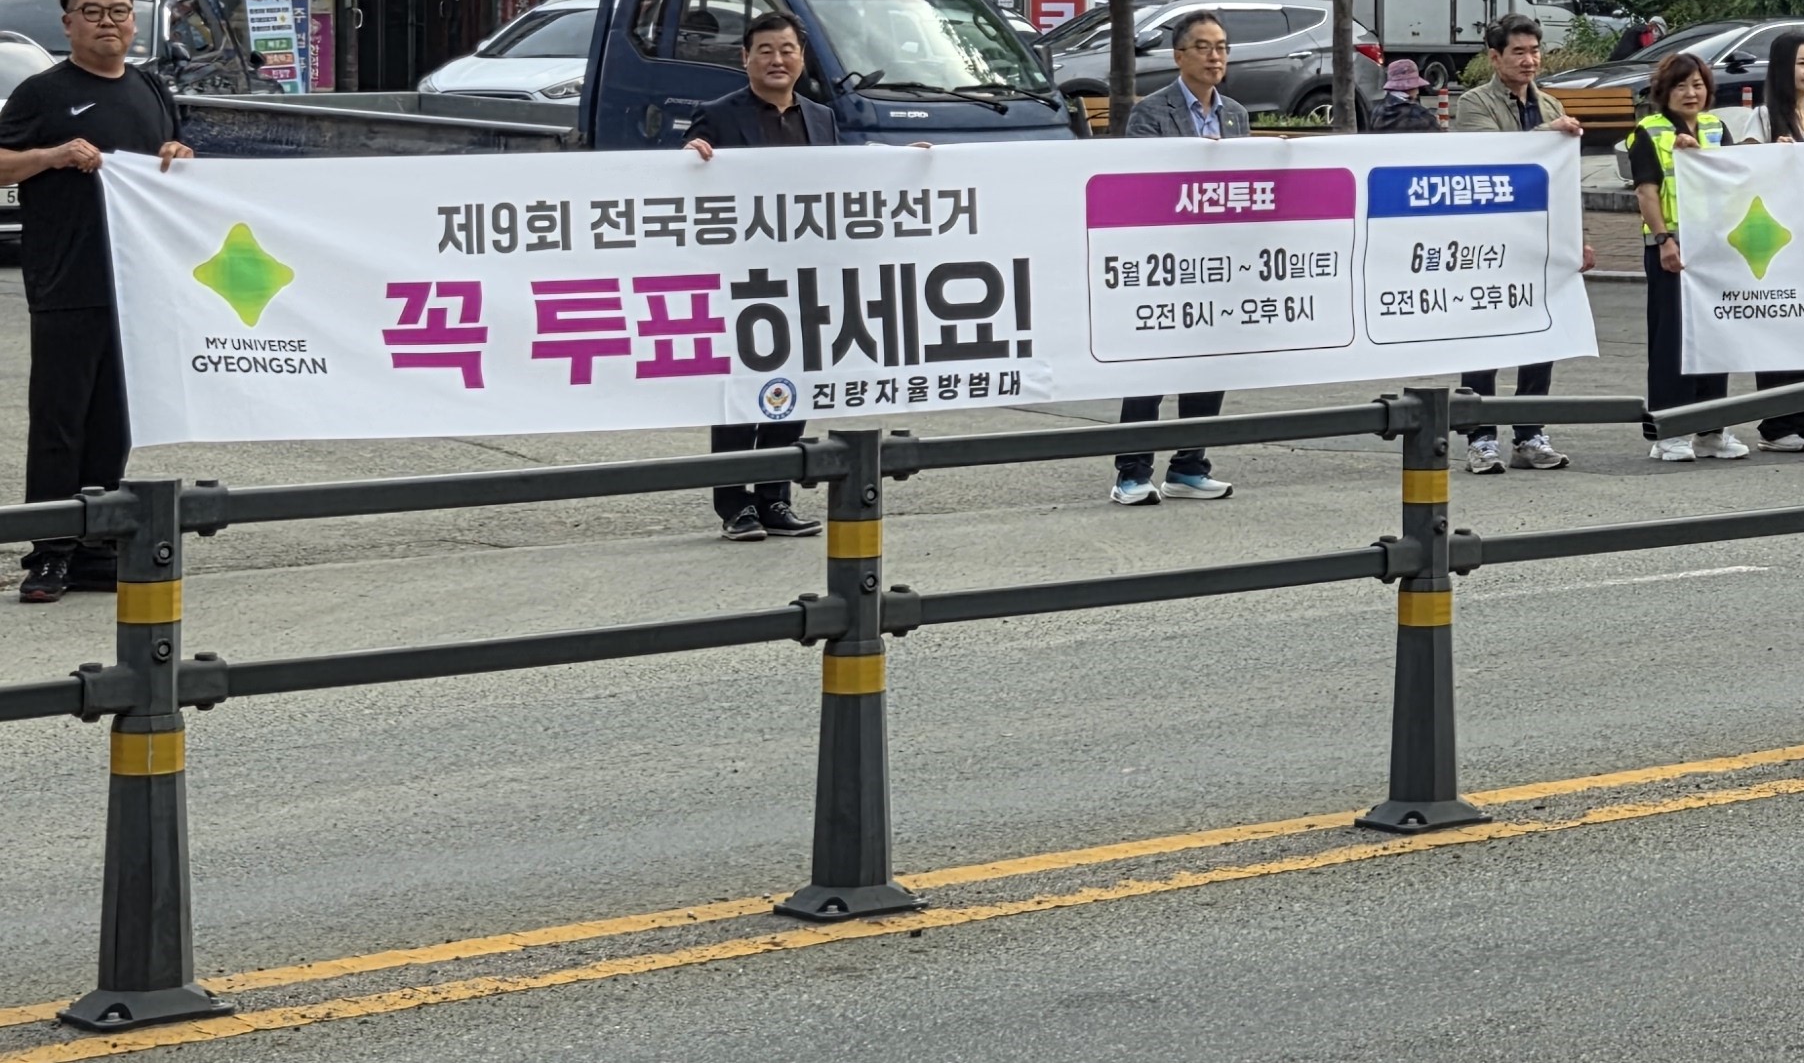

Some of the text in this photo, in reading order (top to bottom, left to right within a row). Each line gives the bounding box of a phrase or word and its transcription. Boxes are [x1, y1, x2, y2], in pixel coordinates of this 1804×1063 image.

[1175, 181, 1276, 214] 사전투표
[1407, 172, 1515, 207] 선거일투표
[437, 188, 978, 256] 제9회 전국동시지방선거
[1103, 246, 1339, 290] 5월 29일(금) 30일(토)
[1410, 239, 1506, 274] 6월 3일(수)
[1379, 287, 1415, 317] 오전
[1419, 285, 1449, 315] 6시
[1469, 283, 1504, 313] 오후
[1507, 282, 1535, 311] 6시
[1722, 288, 1797, 301] MY UNIVERSE
[381, 257, 1033, 390] 꼭 투표하세요!
[1134, 300, 1177, 332] 오전
[1182, 298, 1215, 330] 6시
[1240, 295, 1280, 326] 오후
[1284, 293, 1315, 325] 6시
[205, 337, 308, 354] MY UNIVERSE
[191, 354, 328, 375] GYEONGSAN
[812, 370, 1022, 410] 진량자율방범대
